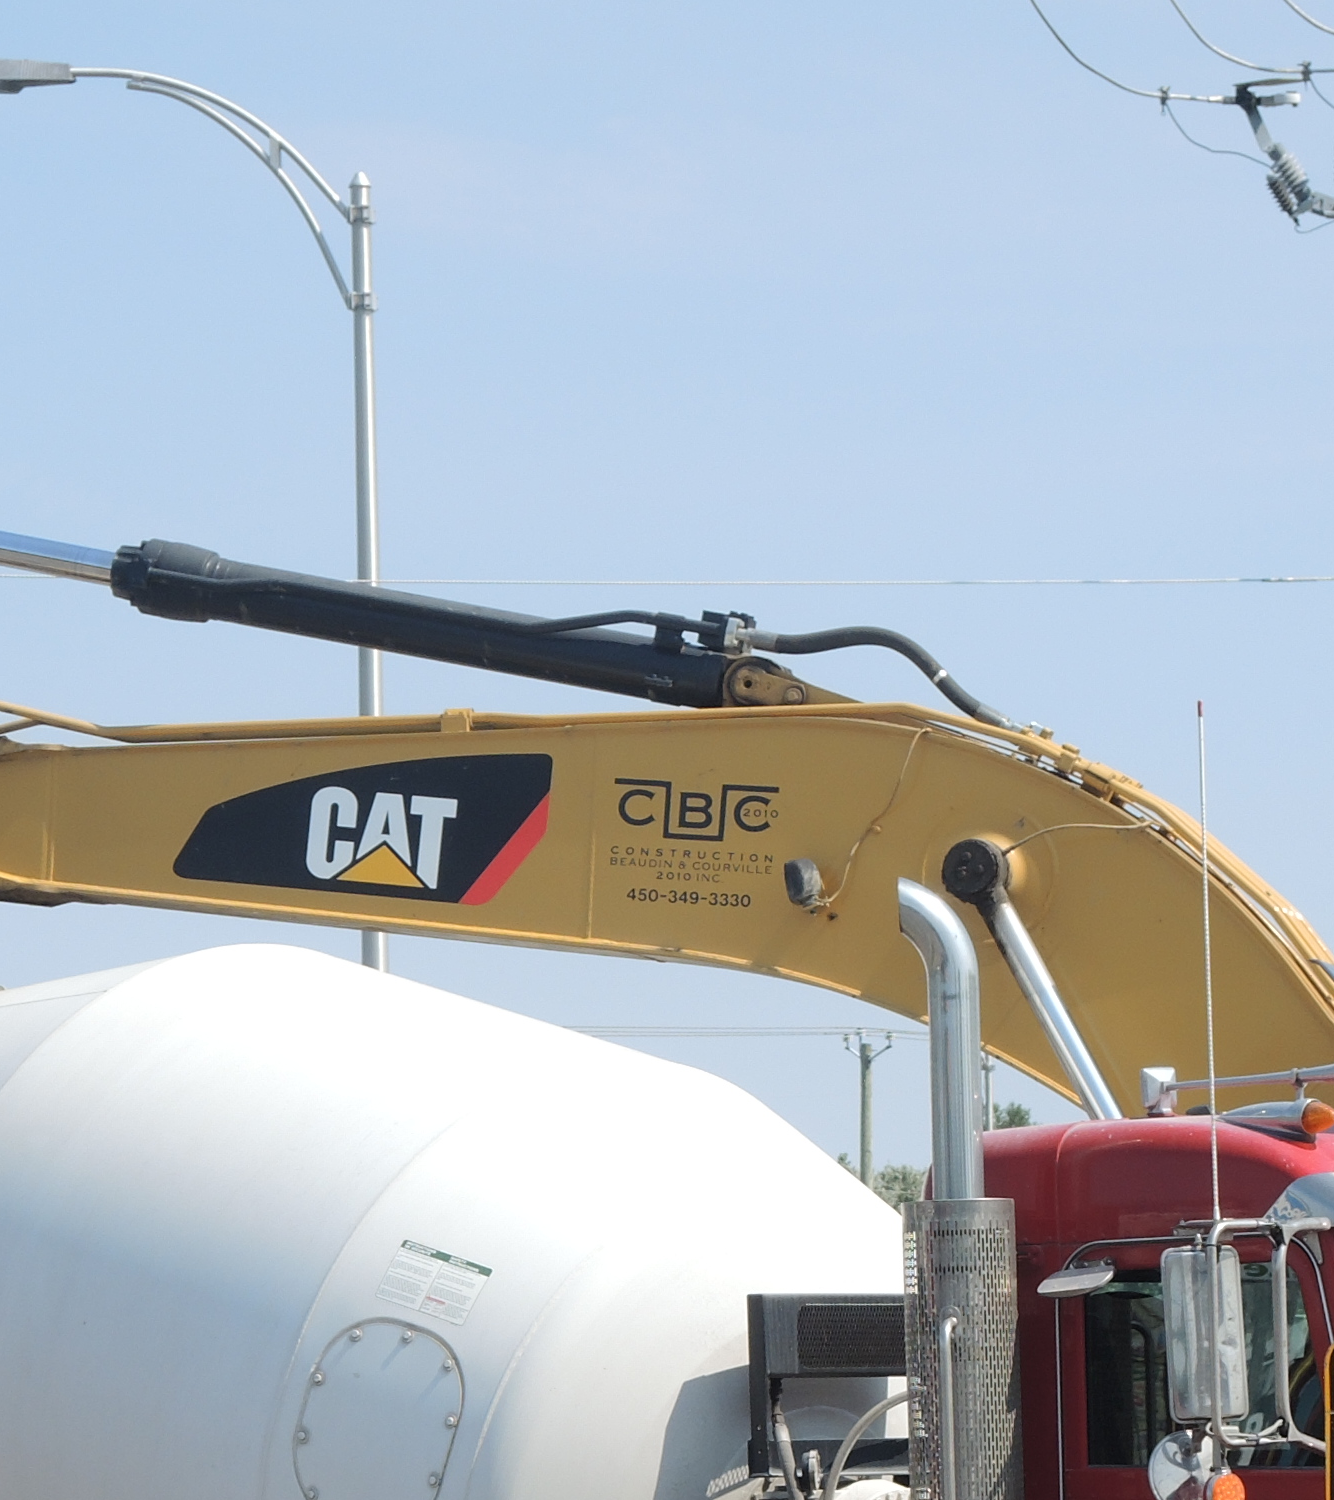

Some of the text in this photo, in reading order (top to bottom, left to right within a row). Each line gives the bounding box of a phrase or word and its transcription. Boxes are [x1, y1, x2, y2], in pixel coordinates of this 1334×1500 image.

[618, 789, 771, 832] CBC
[743, 808, 779, 818] 2010
[306, 786, 458, 889] CAT
[610, 845, 774, 863] CONSTRUCTION
[609, 857, 773, 875] BEAUDIN & COURVILLE
[656, 871, 692, 881] 2010
[626, 888, 752, 908] 450-349-3330
